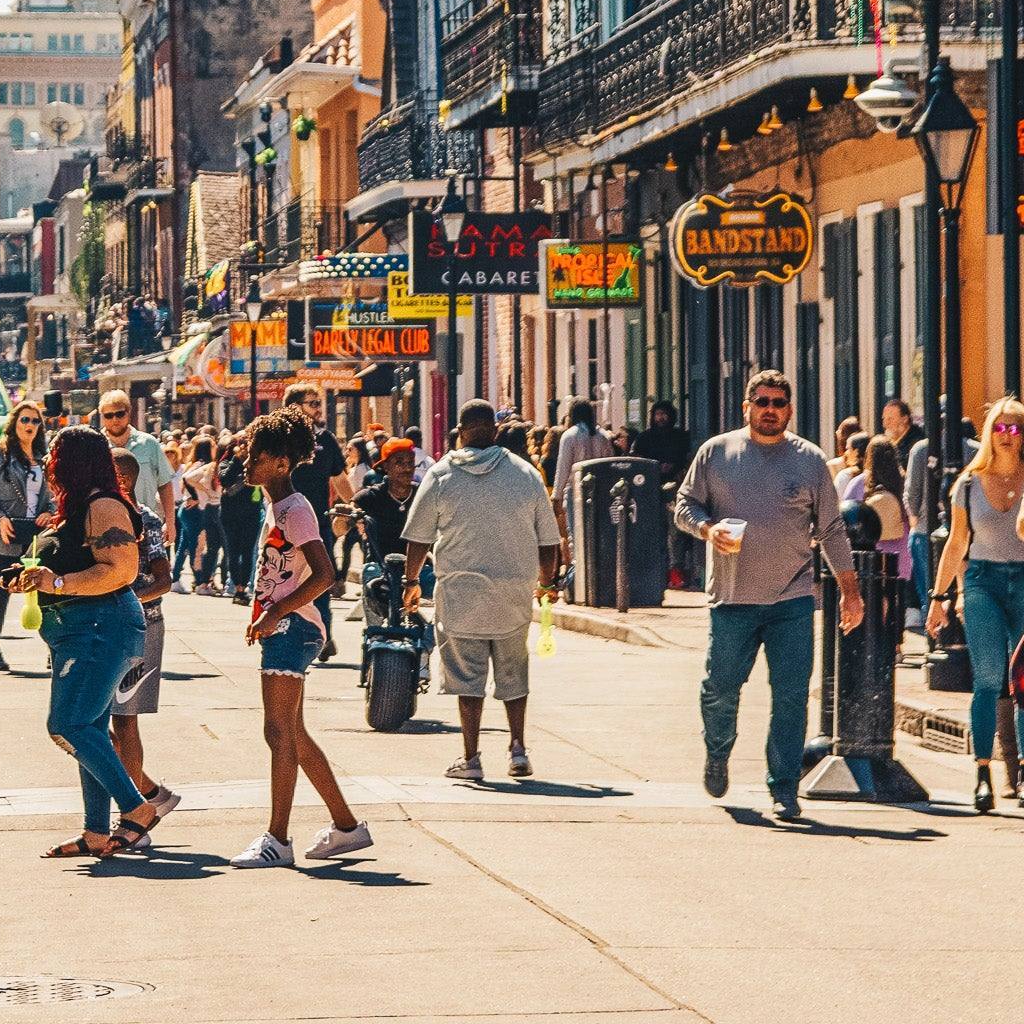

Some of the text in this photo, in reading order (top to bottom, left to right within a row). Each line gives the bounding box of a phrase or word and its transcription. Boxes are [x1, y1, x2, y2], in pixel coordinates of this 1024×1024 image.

[686, 227, 806, 255] BANDSTAND
[362, 328, 398, 355] LEGAL
[400, 327, 430, 353] CLUB
